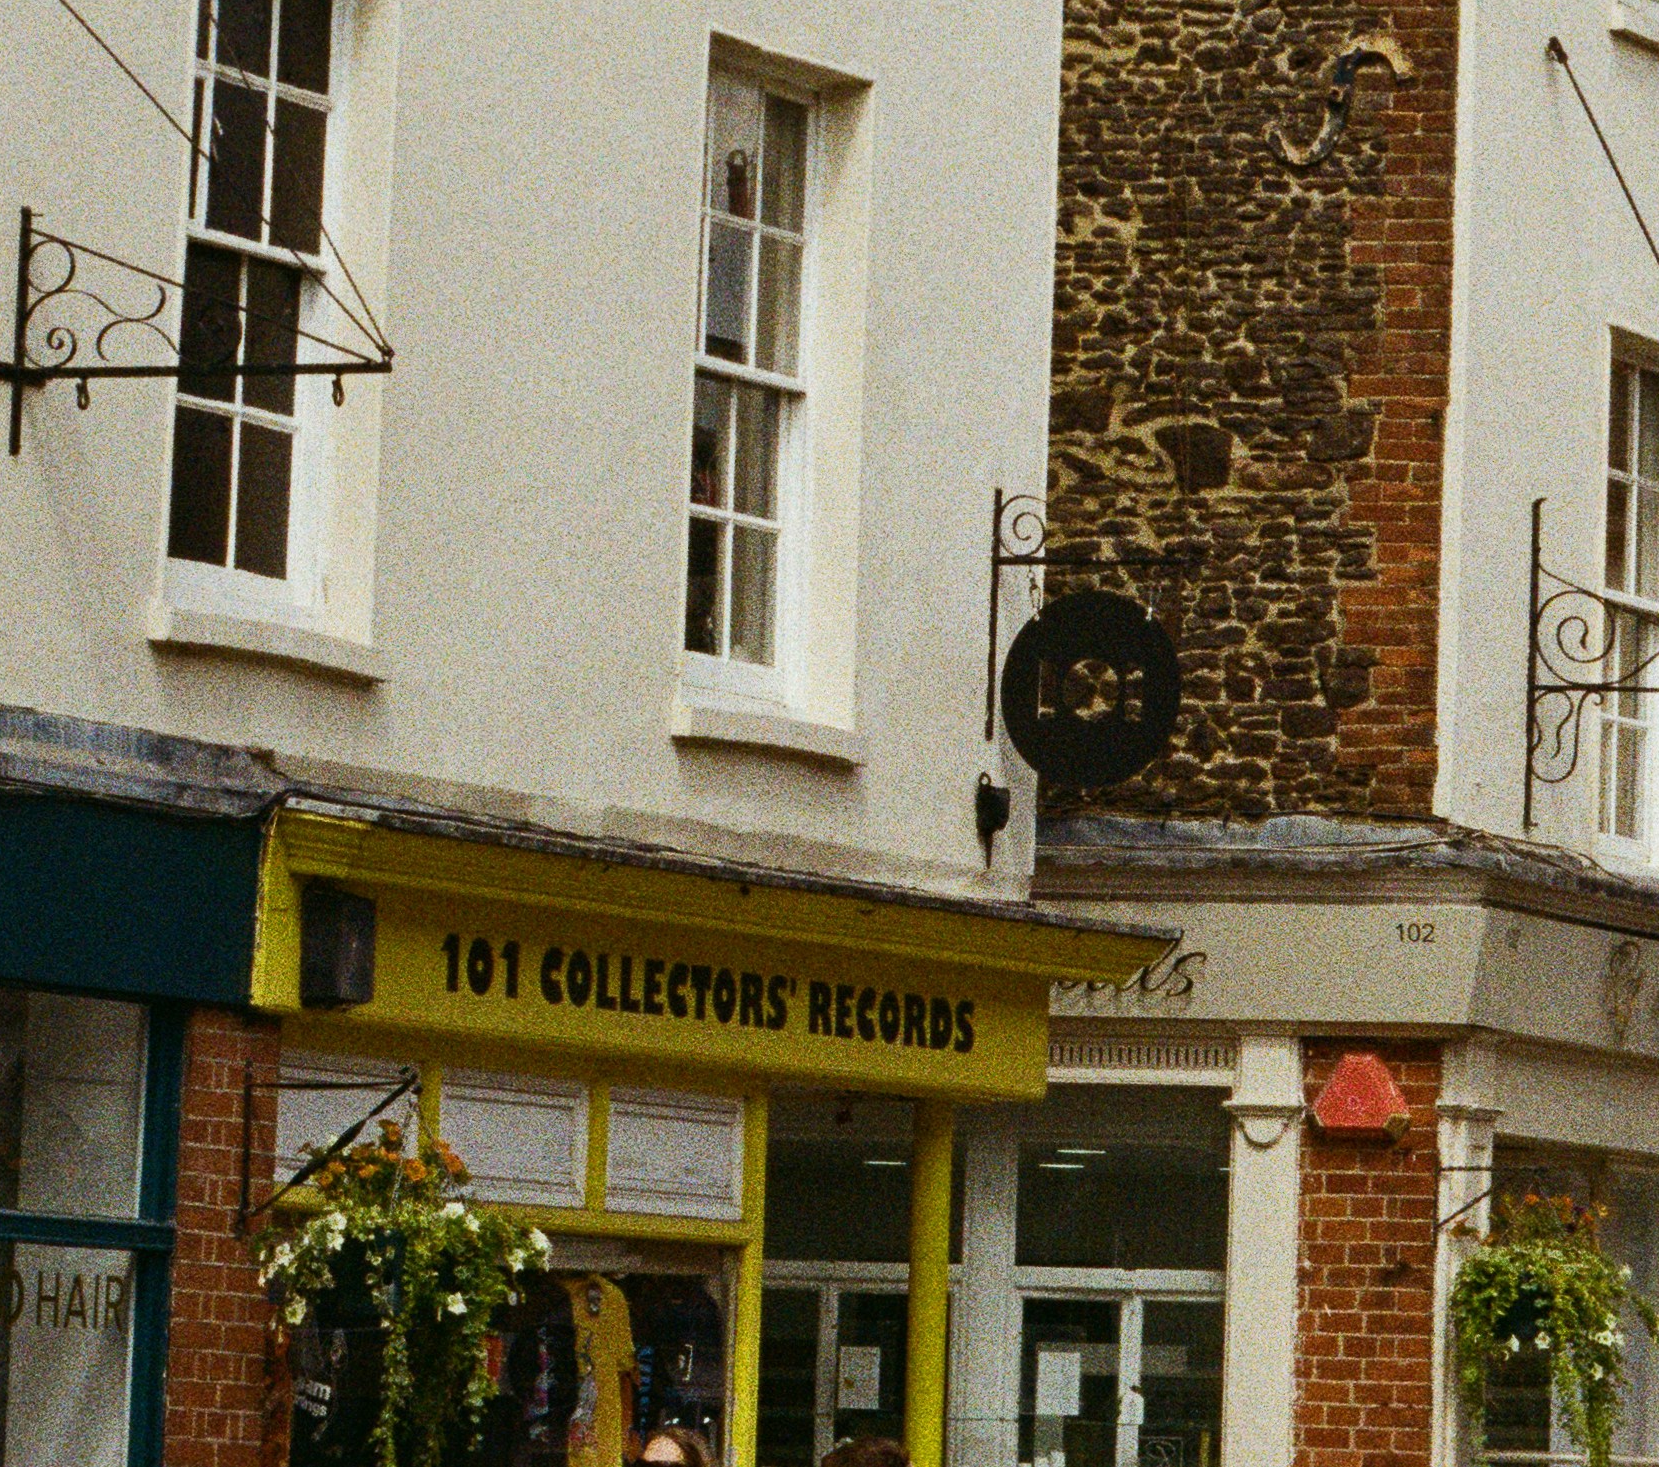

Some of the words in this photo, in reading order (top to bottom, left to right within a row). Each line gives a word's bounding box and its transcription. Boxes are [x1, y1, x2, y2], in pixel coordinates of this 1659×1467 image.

[1395, 922, 1436, 944] 102
[440, 932, 520, 999] 101
[539, 946, 798, 1031] COLLECTORS'
[807, 979, 975, 1054] RECORDS
[36, 1269, 127, 1332] HAIR
